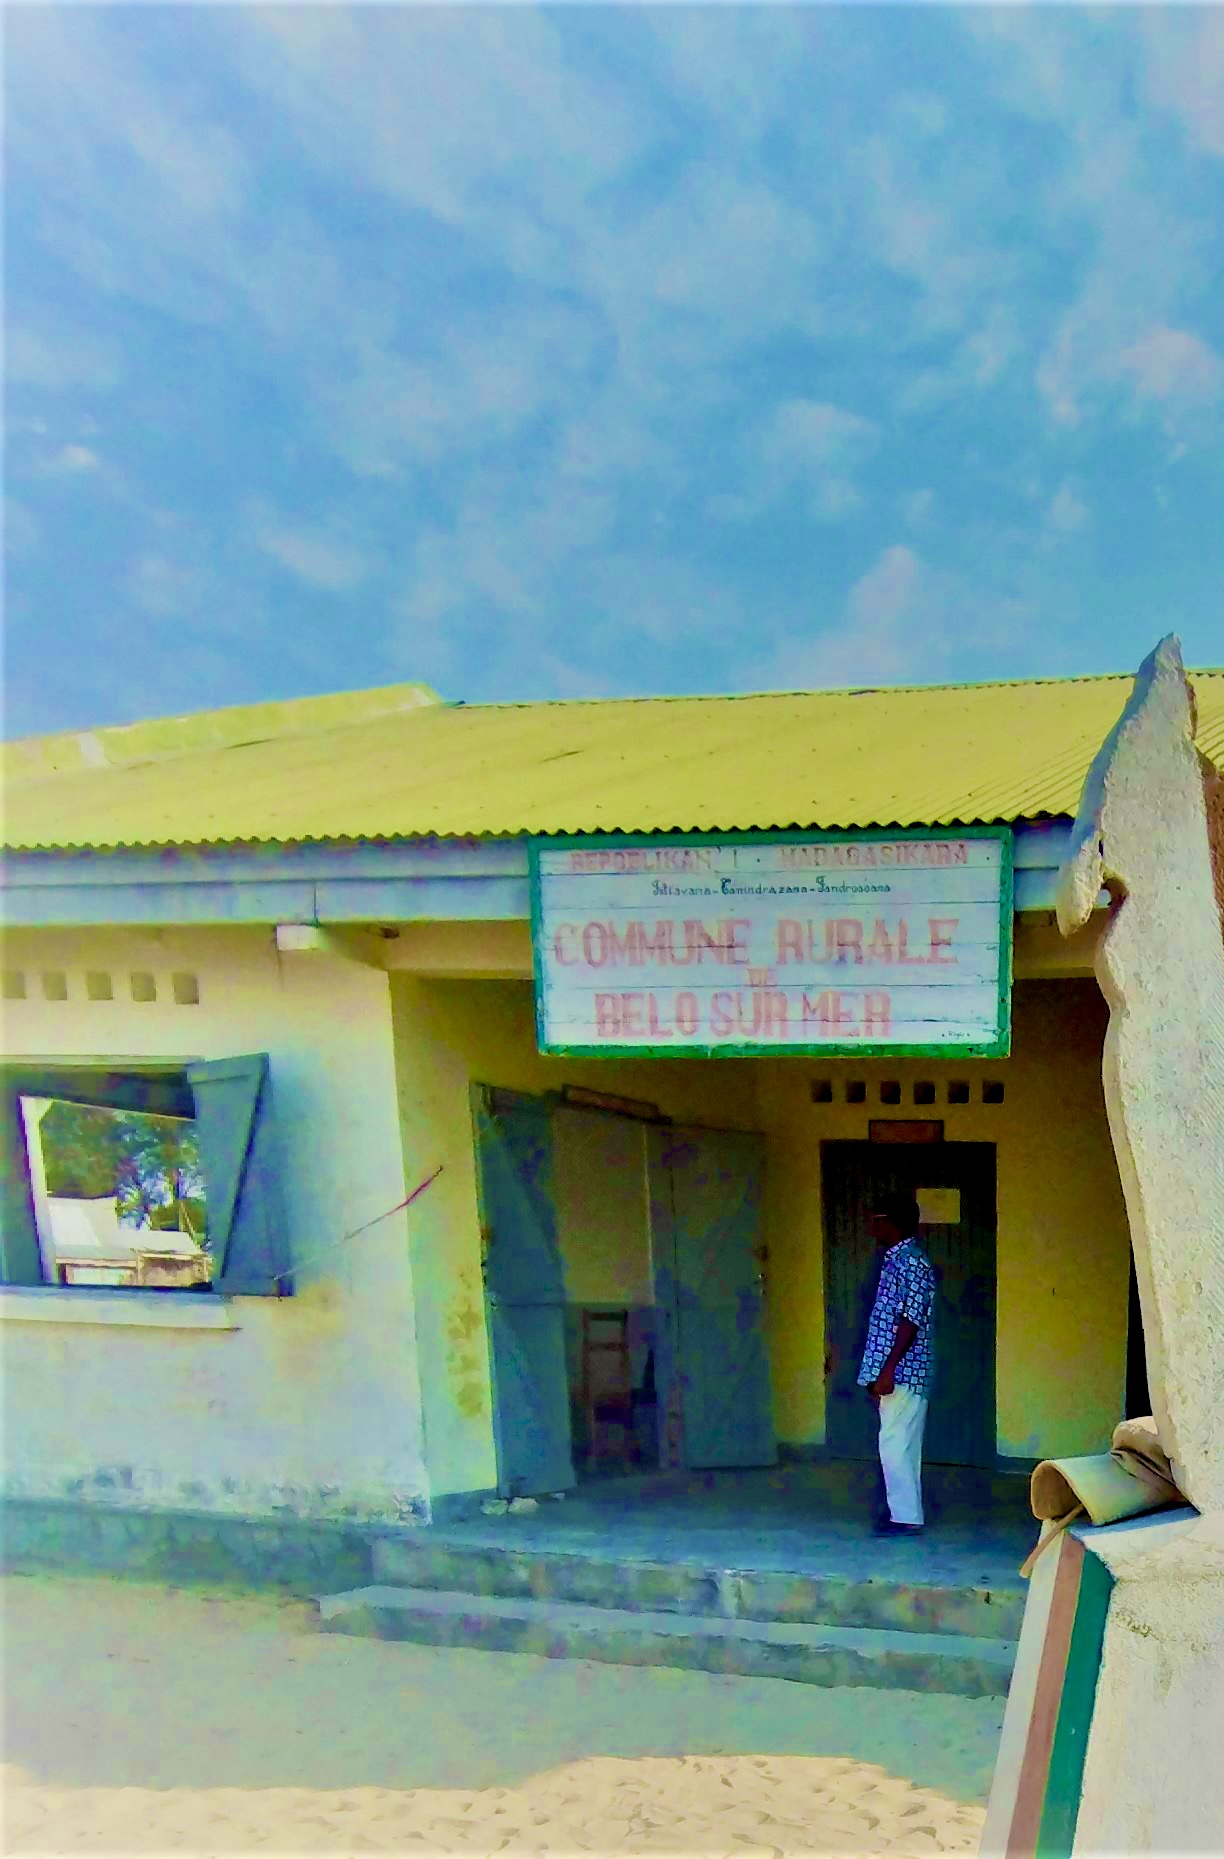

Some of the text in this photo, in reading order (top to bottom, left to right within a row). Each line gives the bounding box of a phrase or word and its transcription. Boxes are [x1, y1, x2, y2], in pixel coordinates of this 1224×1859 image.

[554, 918, 960, 967] COMMUNE RURALE
[594, 990, 891, 1037] BELO SUR MER
